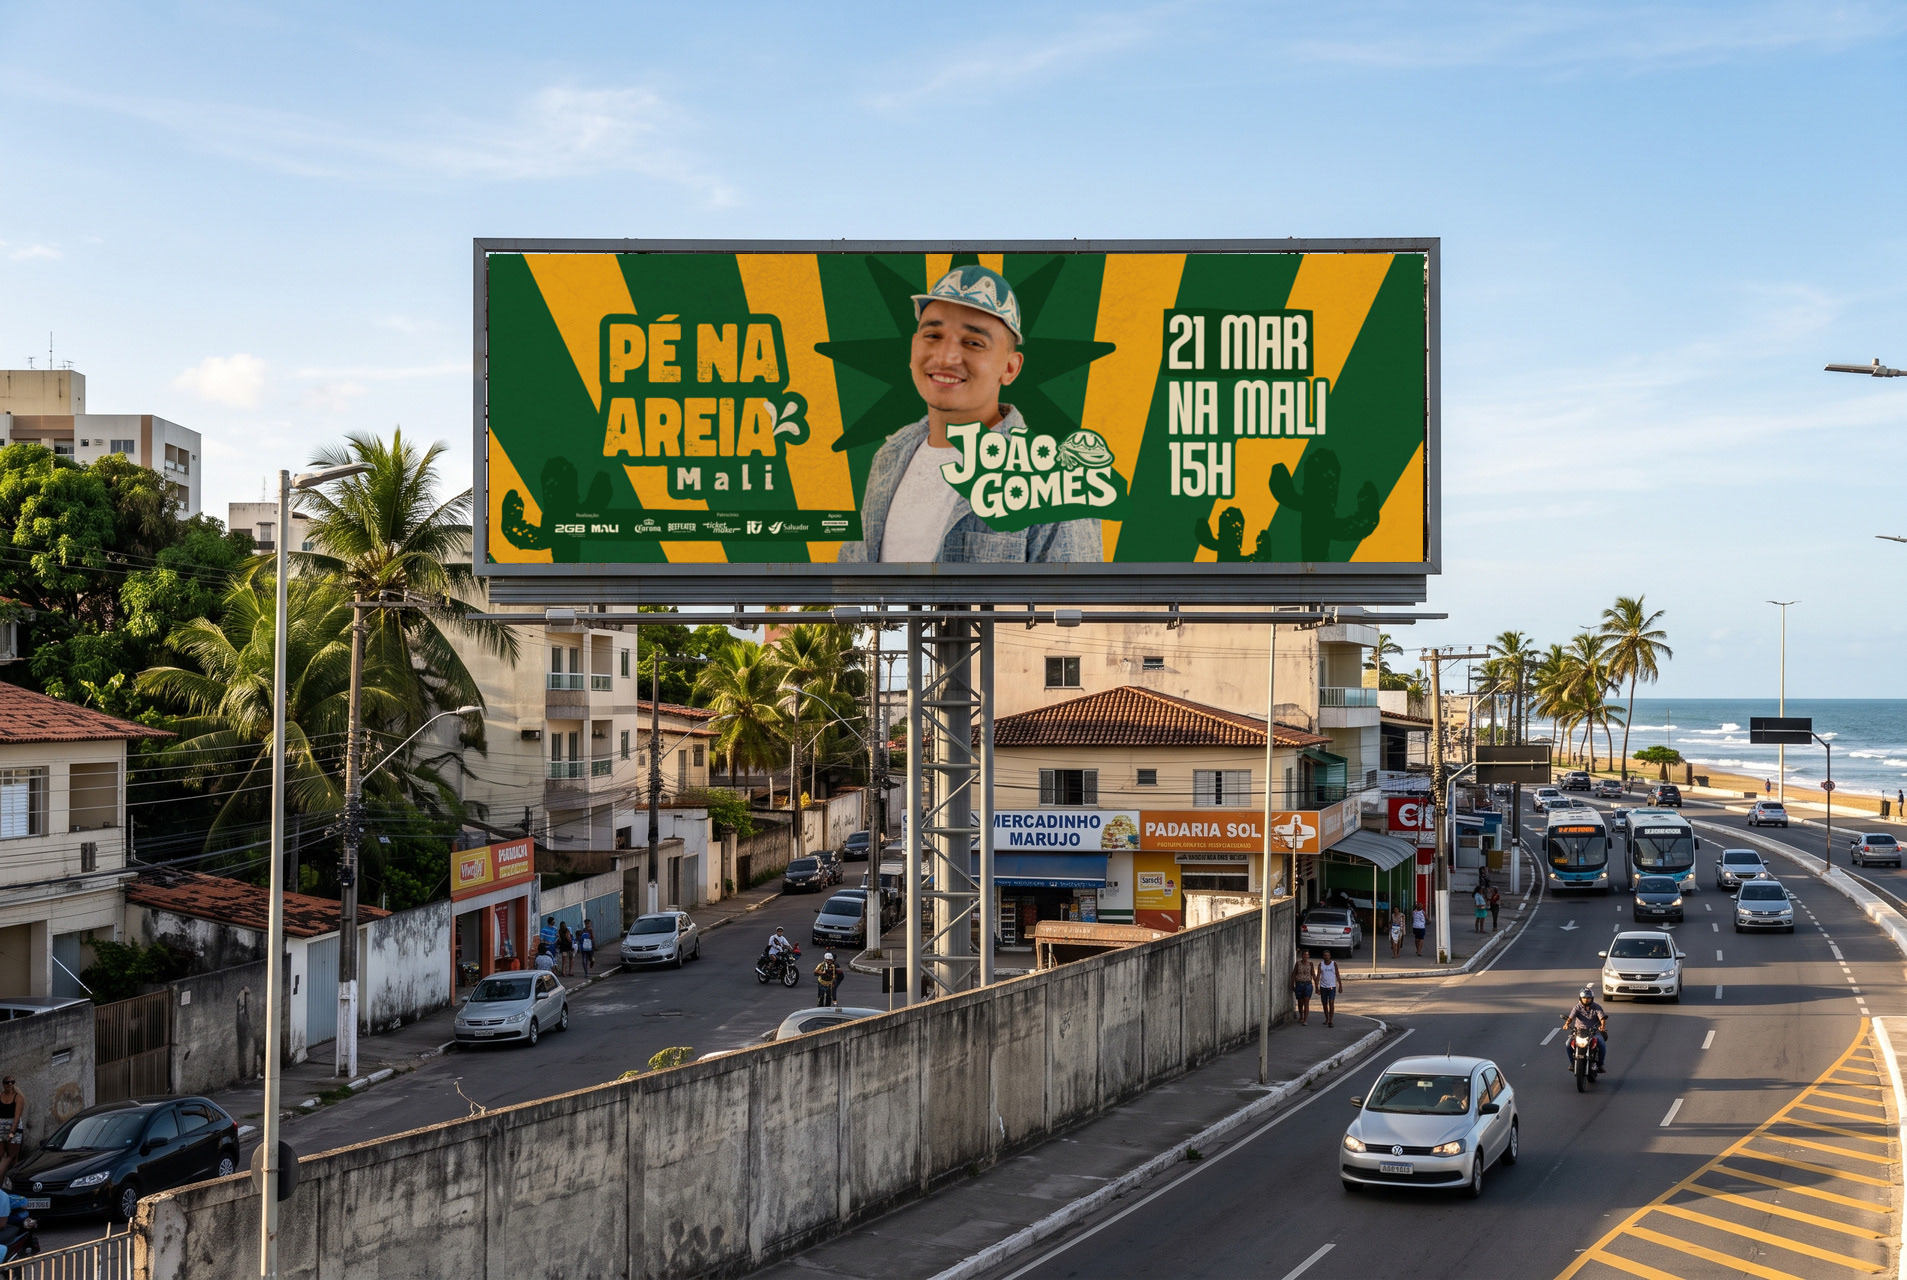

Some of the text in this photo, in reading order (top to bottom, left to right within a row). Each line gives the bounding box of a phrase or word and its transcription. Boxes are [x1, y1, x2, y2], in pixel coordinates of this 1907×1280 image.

[609, 314, 780, 383] PÉ NA
[1169, 314, 1307, 370] 21 MAR
[1169, 380, 1326, 435] NA MALI
[603, 397, 777, 457] AREIA
[940, 421, 1058, 485] JOÃO
[677, 464, 774, 491] Mali
[1169, 442, 1232, 497] 15H
[970, 465, 1118, 519] GOMES
[554, 524, 586, 533] 2GB
[591, 524, 619, 533] MALI
[635, 524, 662, 534] Corona
[667, 522, 697, 532] BEEFEATER
[783, 523, 809, 531] Salvador
[1009, 832, 1081, 847] MARUJO
[1145, 822, 1262, 838] PADARIA SOL
